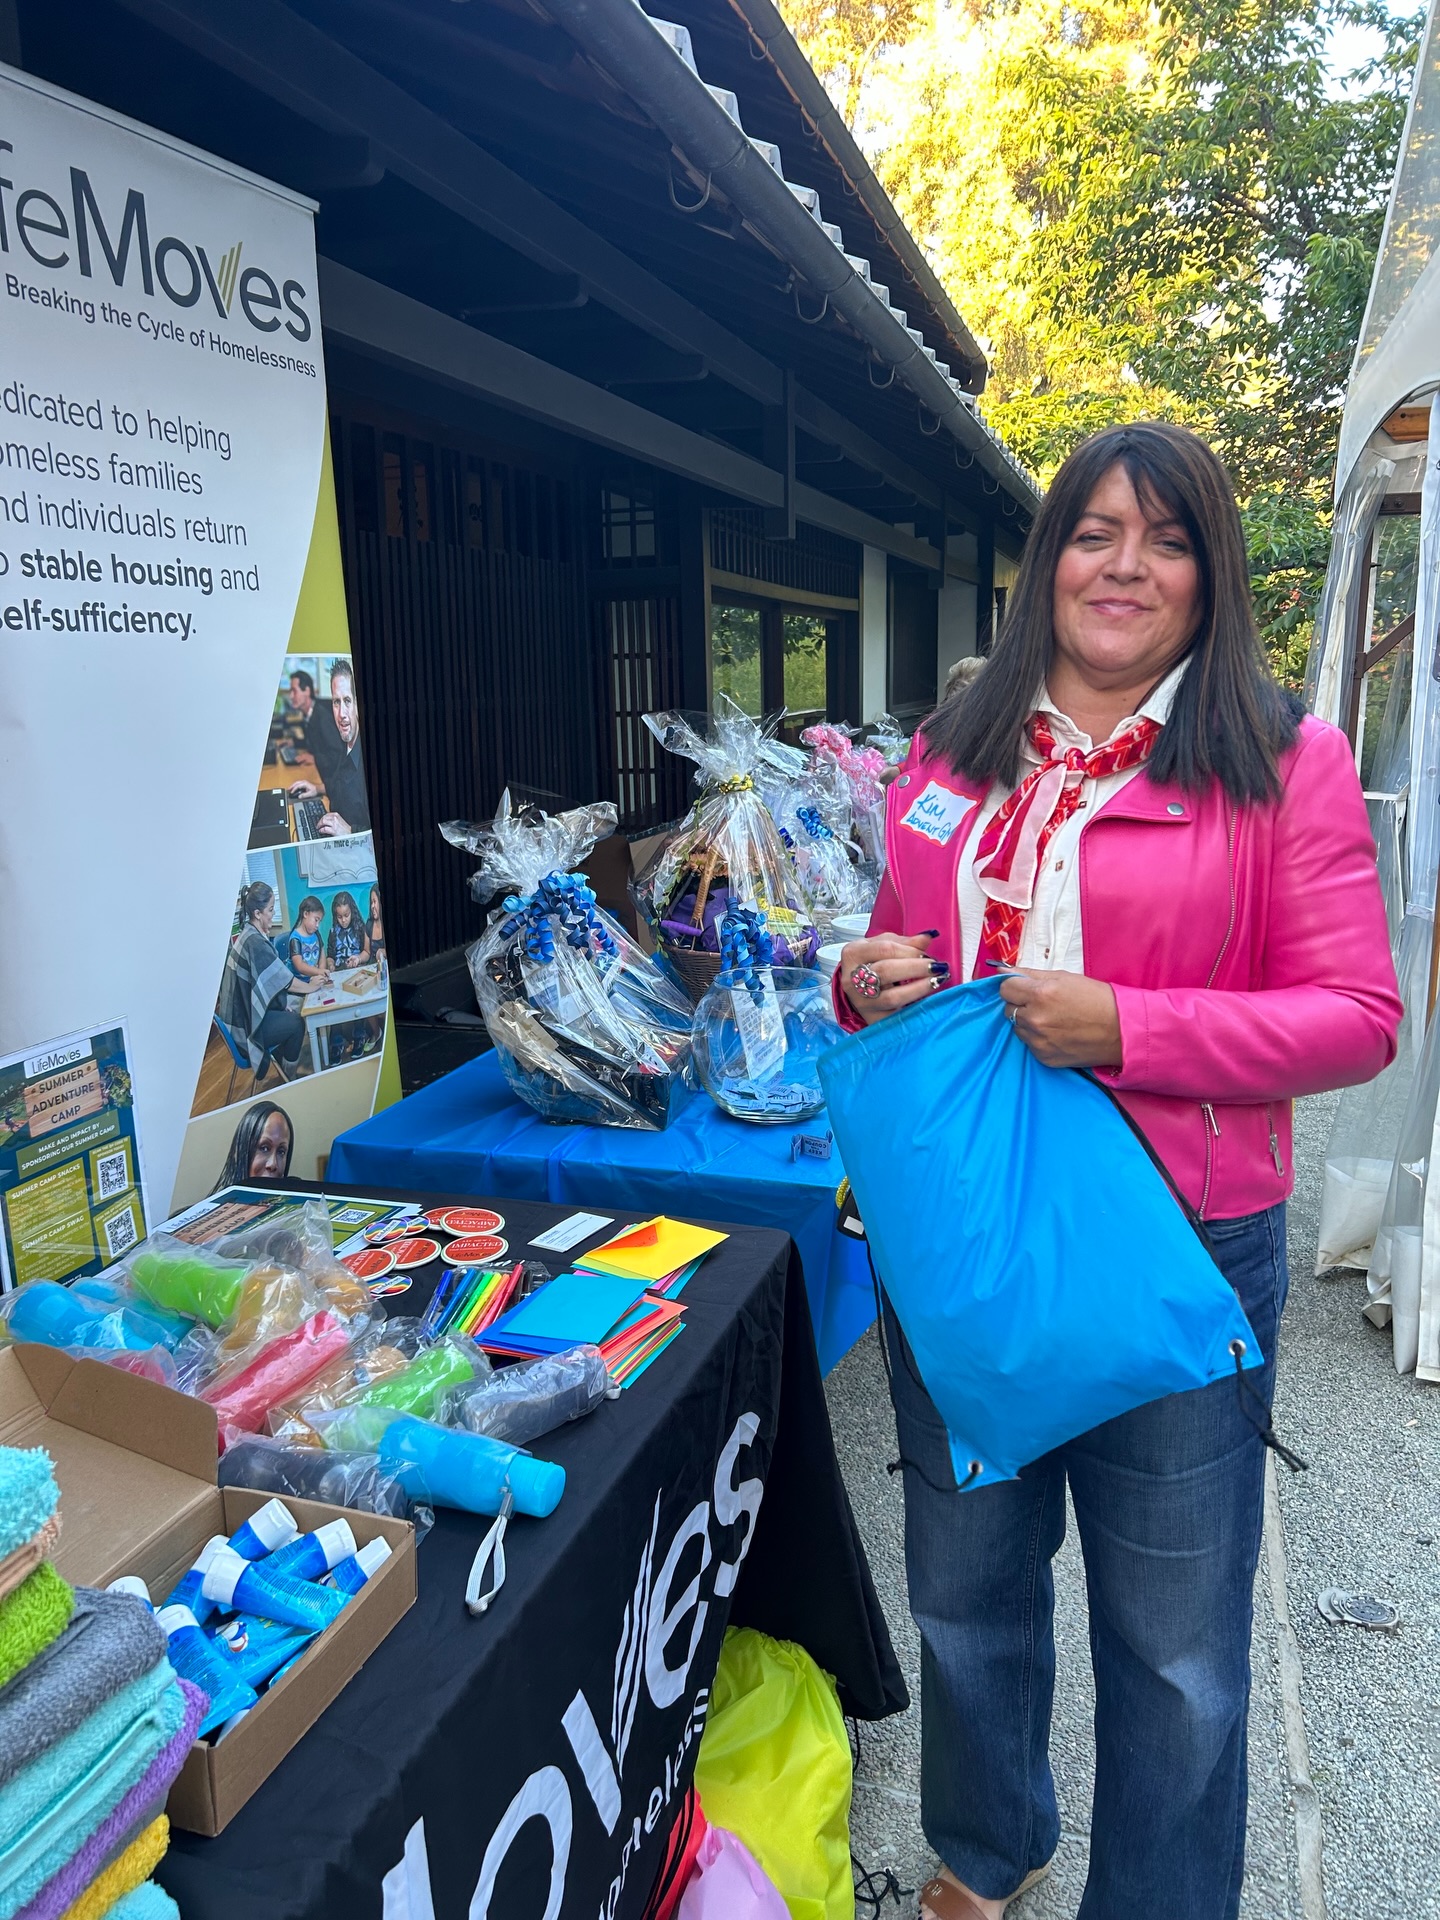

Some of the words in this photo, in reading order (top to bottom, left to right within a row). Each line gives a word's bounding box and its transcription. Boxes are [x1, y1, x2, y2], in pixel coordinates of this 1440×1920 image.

[5, 272, 96, 324] Breaking
[100, 301, 132, 328] the
[137, 311, 185, 344] Cycle
[190, 328, 205, 349] of
[209, 334, 317, 378] Homelessness
[0, 380, 104, 431] dicated
[111, 404, 138, 436] to
[147, 409, 232, 461] helping
[108, 452, 203, 495] families
[37, 494, 176, 540] individuals
[184, 516, 248, 547] return
[20, 548, 103, 583] stable
[110, 553, 214, 596] housing
[220, 565, 260, 591] and
[0, 598, 198, 641] elf-sufficiency.
[31, 1049, 81, 1074] LifeMoves
[32, 1082, 95, 1115] ADVENTURE
[39, 1069, 84, 1094] SUMMER
[51, 1105, 81, 1124] CAMP
[21, 1150, 61, 1170] SPONSORING
[61, 1144, 75, 1153] OUR
[75, 1132, 98, 1147] SUMMER
[99, 1124, 115, 1137] CAMP
[38, 1142, 56, 1153] MAKE
[57, 1136, 70, 1145] AND
[70, 1126, 92, 1140] IMPACT
[93, 1122, 100, 1130] BY
[804, 1140, 827, 1149] COUPON
[11, 1183, 38, 1200] SUMMER
[39, 1174, 57, 1187] CAMP
[57, 1163, 81, 1176] SNACKS
[22, 1234, 48, 1251] SUMMER
[49, 1225, 66, 1238] CAMP
[67, 1215, 85, 1228] SWAG
[218, 1216, 245, 1233] CAMP
